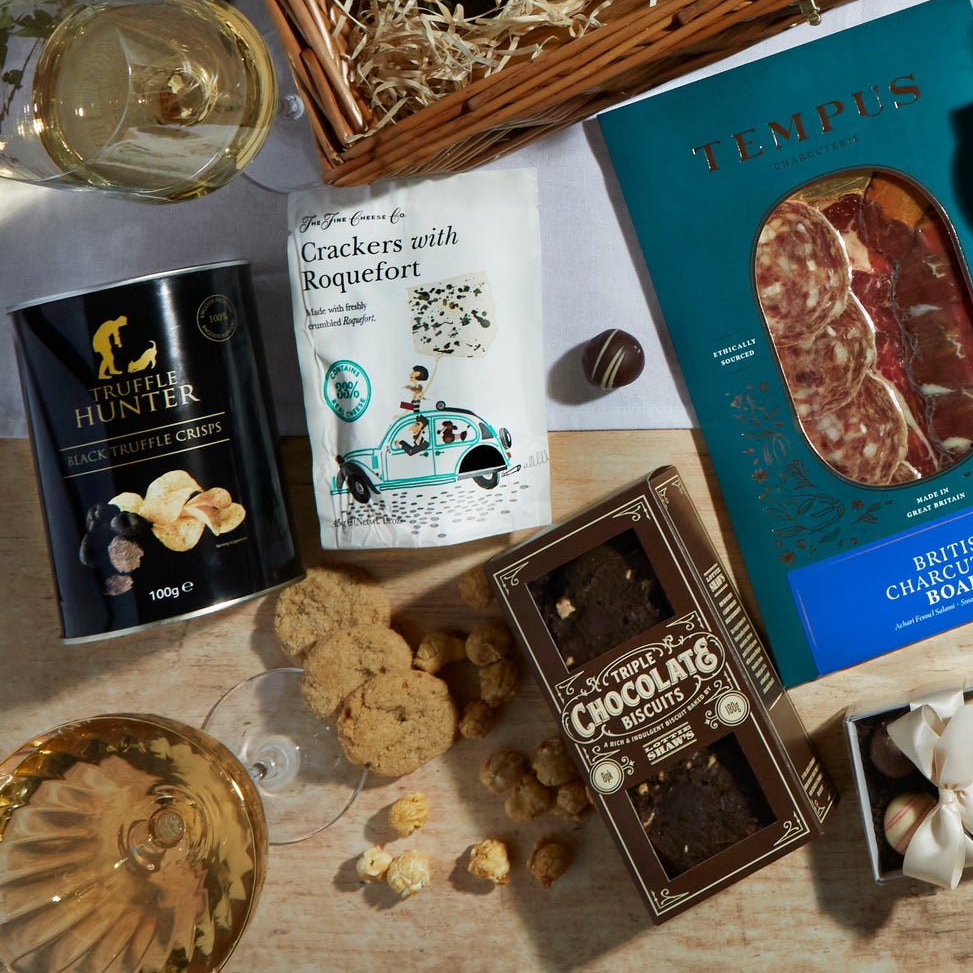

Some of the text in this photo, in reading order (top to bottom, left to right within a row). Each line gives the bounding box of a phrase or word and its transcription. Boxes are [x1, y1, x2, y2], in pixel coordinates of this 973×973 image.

[691, 73, 922, 174] TEMPUS
[772, 135, 860, 170] CHARCUTERIE
[301, 225, 459, 263] Crackers with
[301, 261, 421, 293] Roquefort
[306, 302, 367, 316] Made with freshly
[713, 338, 756, 358] ETHICALLY
[721, 350, 755, 366] SOURCED
[89, 370, 178, 403] TRUFFLE
[329, 365, 360, 380] CONTAINS
[74, 383, 201, 429] HUNTER
[67, 420, 223, 468] BLACK TRUFFLE CRISPS
[907, 492, 966, 518] GREAT BRITAIN
[916, 491, 939, 504] MADE
[149, 585, 179, 601] 100g
[611, 652, 657, 684] TRIPLE
[570, 636, 717, 738] CHOCOLATE
[620, 687, 685, 730] BISCUITS
[631, 724, 665, 743] INDULGENT
[665, 709, 688, 727] BISCUIT
[687, 695, 704, 711] BAKED
[703, 686, 712, 696] BY
[644, 724, 692, 753] LOTTIE
[646, 729, 695, 762] SHAW'S
